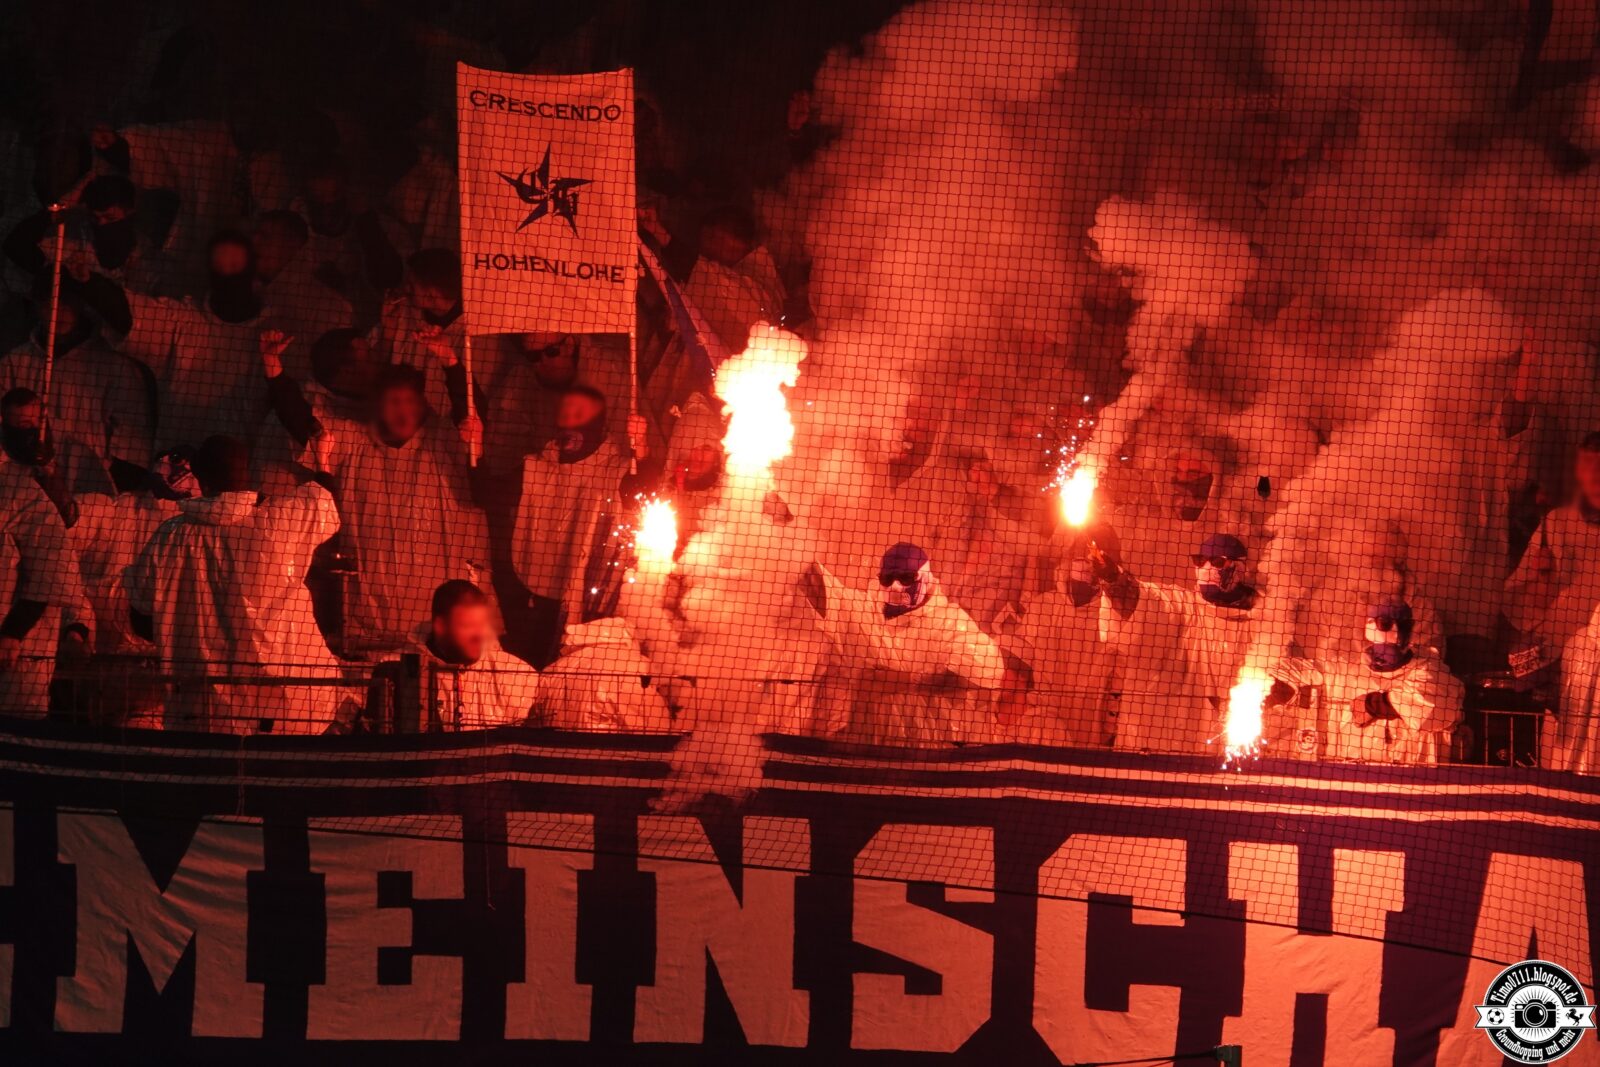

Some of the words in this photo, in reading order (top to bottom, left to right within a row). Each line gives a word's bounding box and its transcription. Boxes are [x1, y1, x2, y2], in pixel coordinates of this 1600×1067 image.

[469, 89, 622, 122] CRESCENDO
[474, 253, 625, 284] HOHENLOHE
[0, 806, 1600, 1067] MEINSCHA
